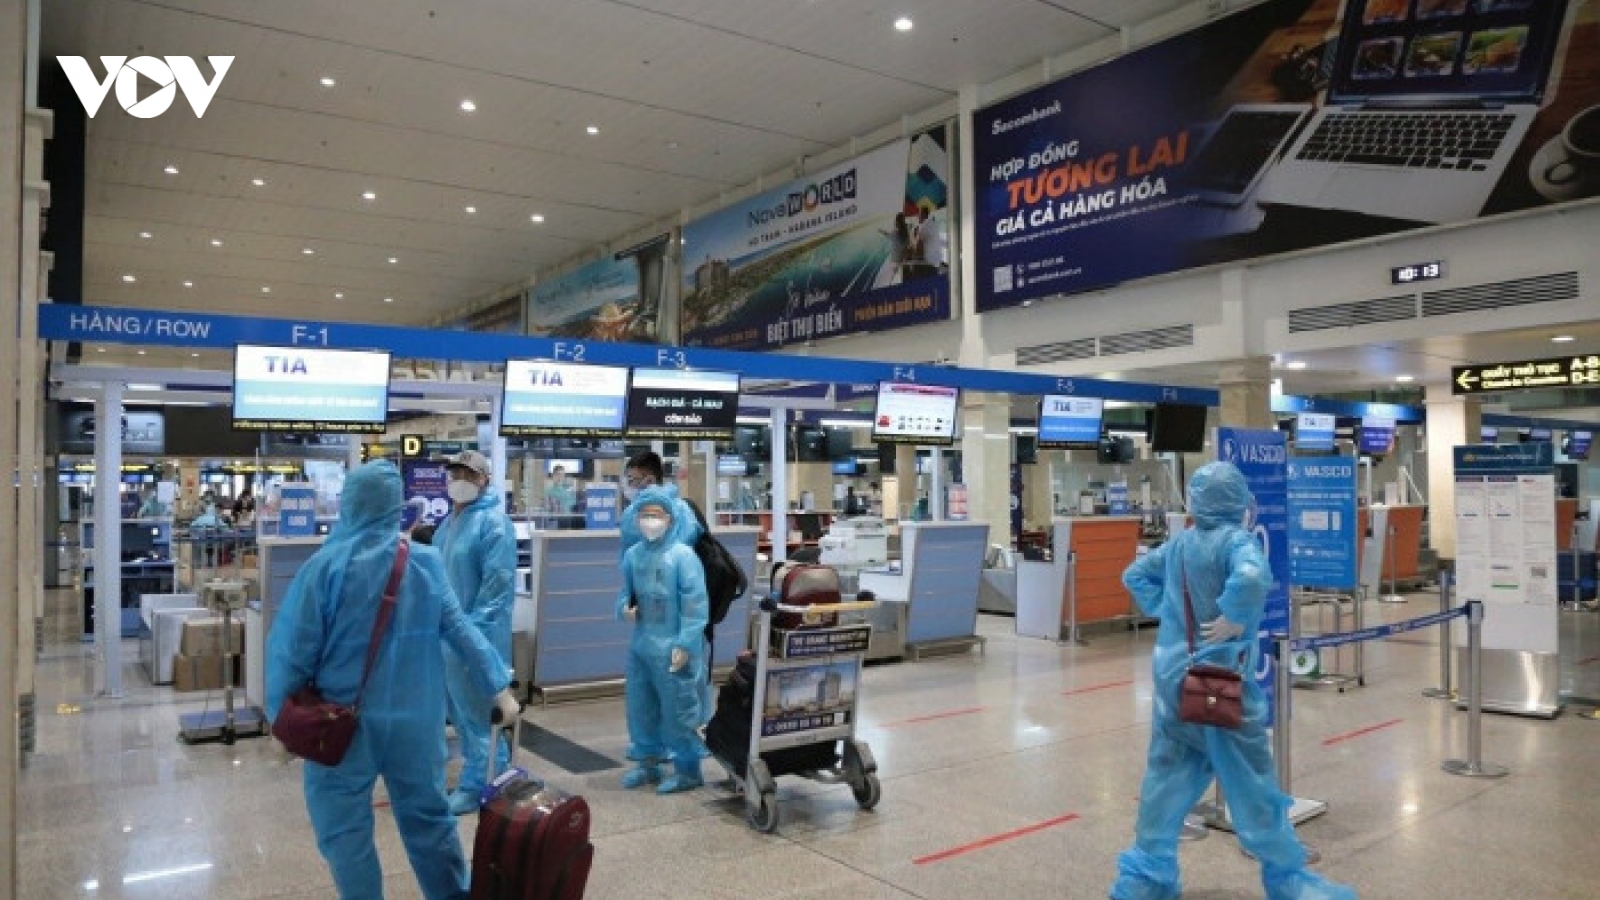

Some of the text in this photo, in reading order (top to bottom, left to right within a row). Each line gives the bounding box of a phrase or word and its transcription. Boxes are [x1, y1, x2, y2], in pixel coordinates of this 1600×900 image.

[991, 99, 1062, 135] Sacombank
[990, 140, 1080, 181] HỢP ĐỒNG
[1007, 129, 1190, 210] TƯƠNG LAI
[996, 209, 1025, 236] GIÁ
[1030, 199, 1055, 227] CẢ
[1059, 190, 1116, 220] HÀNG
[1119, 175, 1167, 204] HÓA
[292, 325, 329, 346] F-1
[554, 342, 586, 362] F-2
[657, 349, 687, 369] F-3
[264, 355, 308, 375] TIA
[528, 369, 563, 387] TIA
[404, 438, 421, 455] D
[1240, 444, 1285, 464] VASCO
[1304, 465, 1352, 477] VASCO
